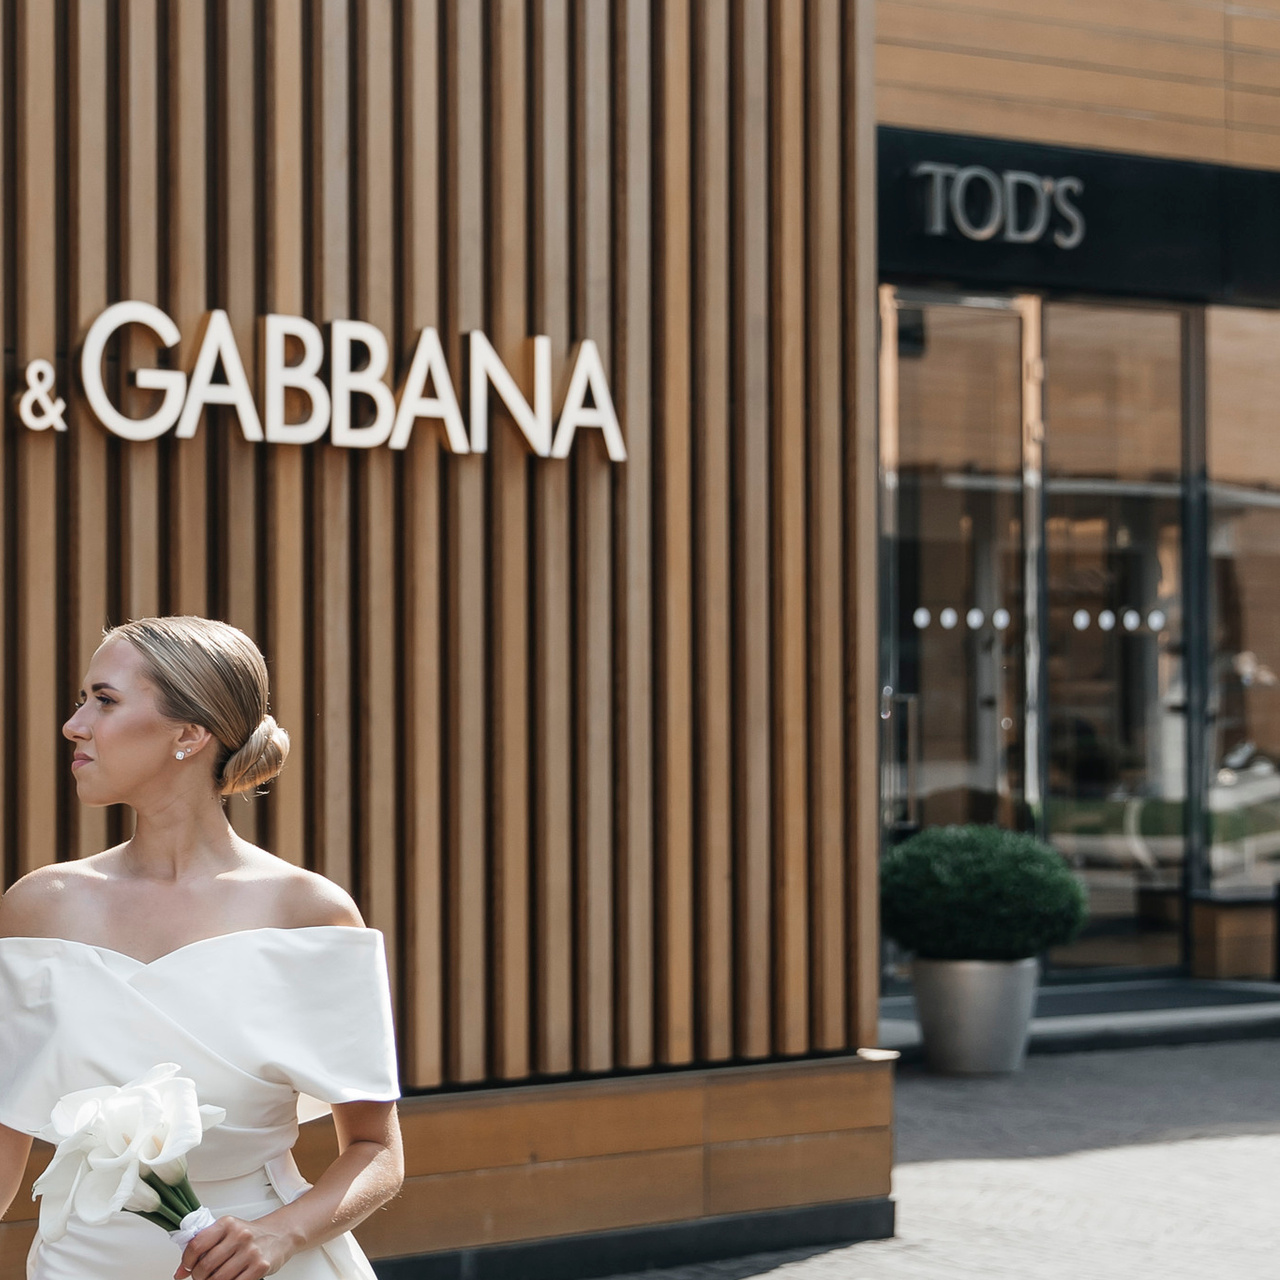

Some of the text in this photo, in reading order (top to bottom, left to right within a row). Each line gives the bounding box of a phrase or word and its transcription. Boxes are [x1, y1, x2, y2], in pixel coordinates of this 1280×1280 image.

[913, 161, 1086, 249] TOD'S
[18, 357, 67, 432] &
[80, 300, 627, 461] GABBANA
